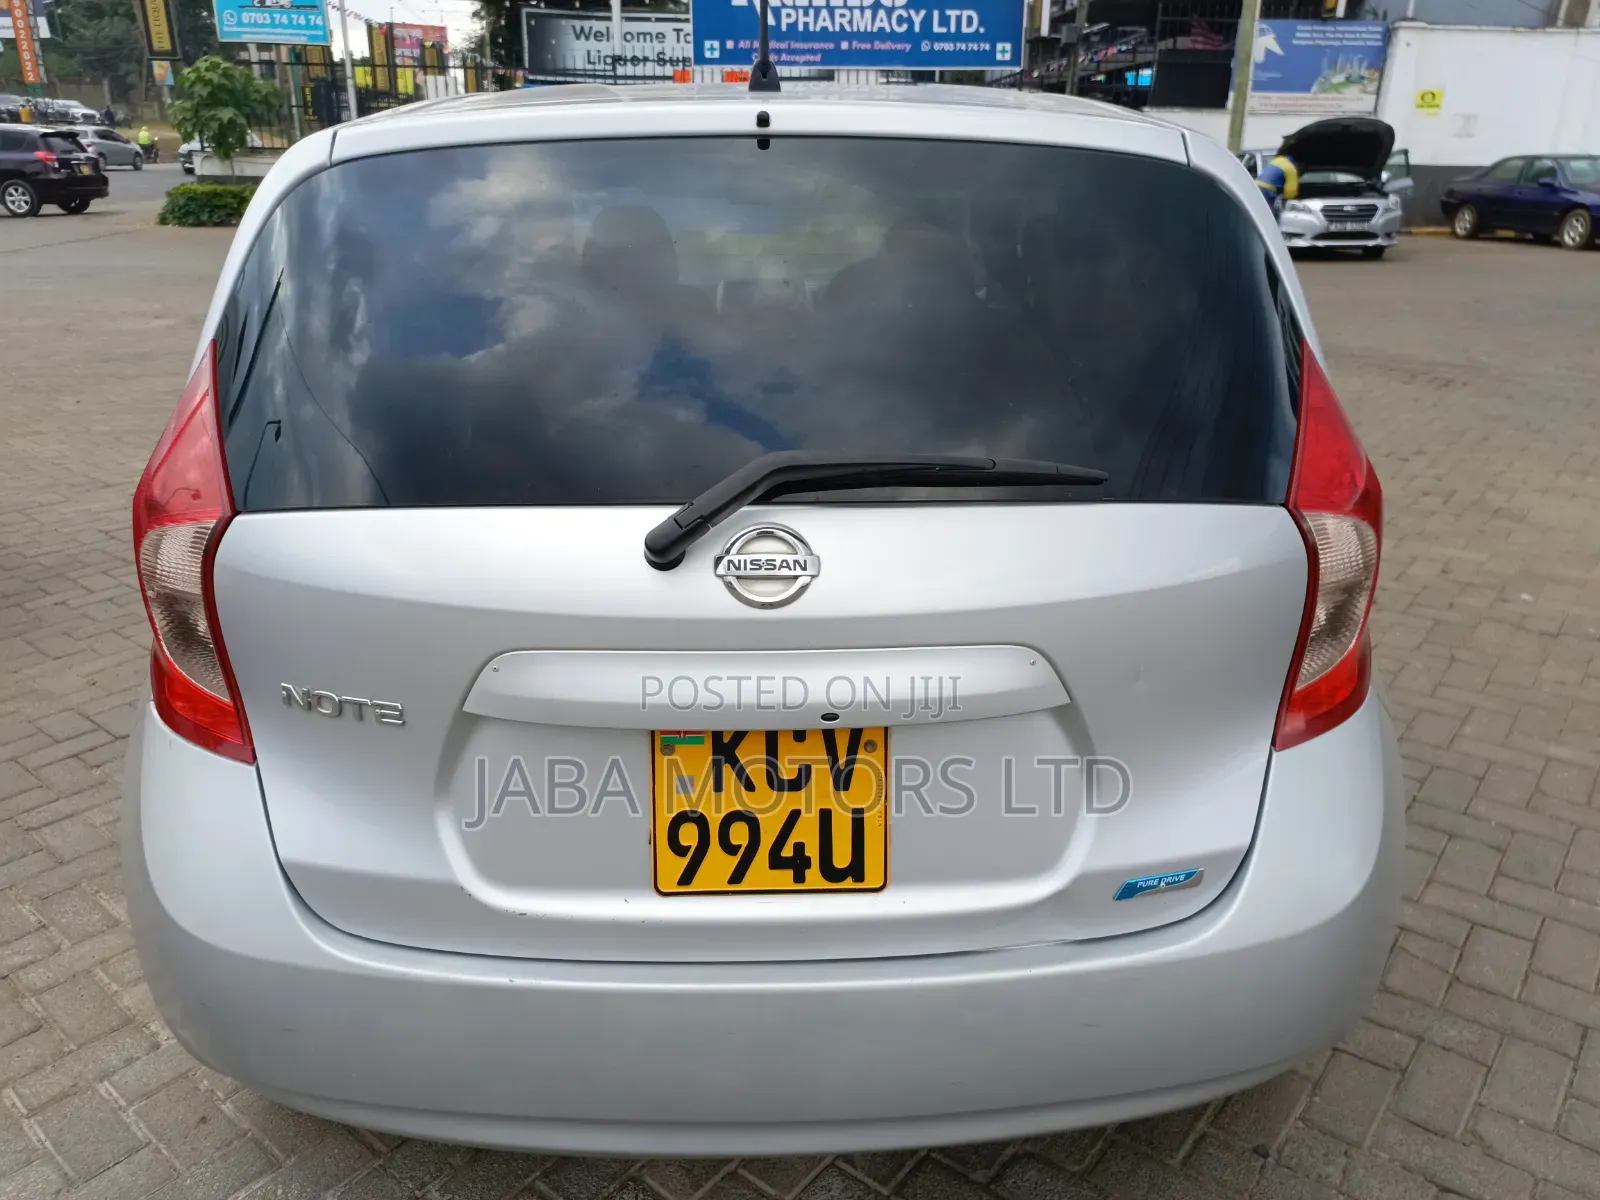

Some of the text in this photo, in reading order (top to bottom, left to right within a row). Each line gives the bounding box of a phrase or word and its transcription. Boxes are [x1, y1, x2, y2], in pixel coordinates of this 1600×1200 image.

[242, 12, 324, 26] 0703 74 74 74
[780, 8, 985, 34] PHARMACY LTD.
[571, 24, 667, 43] Welome
[738, 41, 835, 50] All Mdical Insurance
[852, 41, 912, 52] Free Delivery
[587, 50, 649, 67] Liquor
[780, 53, 821, 62] Accepted
[727, 559, 807, 571] NISSAN
[281, 682, 405, 724] NOTE
[711, 729, 864, 792] KCV
[667, 809, 865, 886] 994U
[1137, 874, 1186, 888] PURE DRIVE
